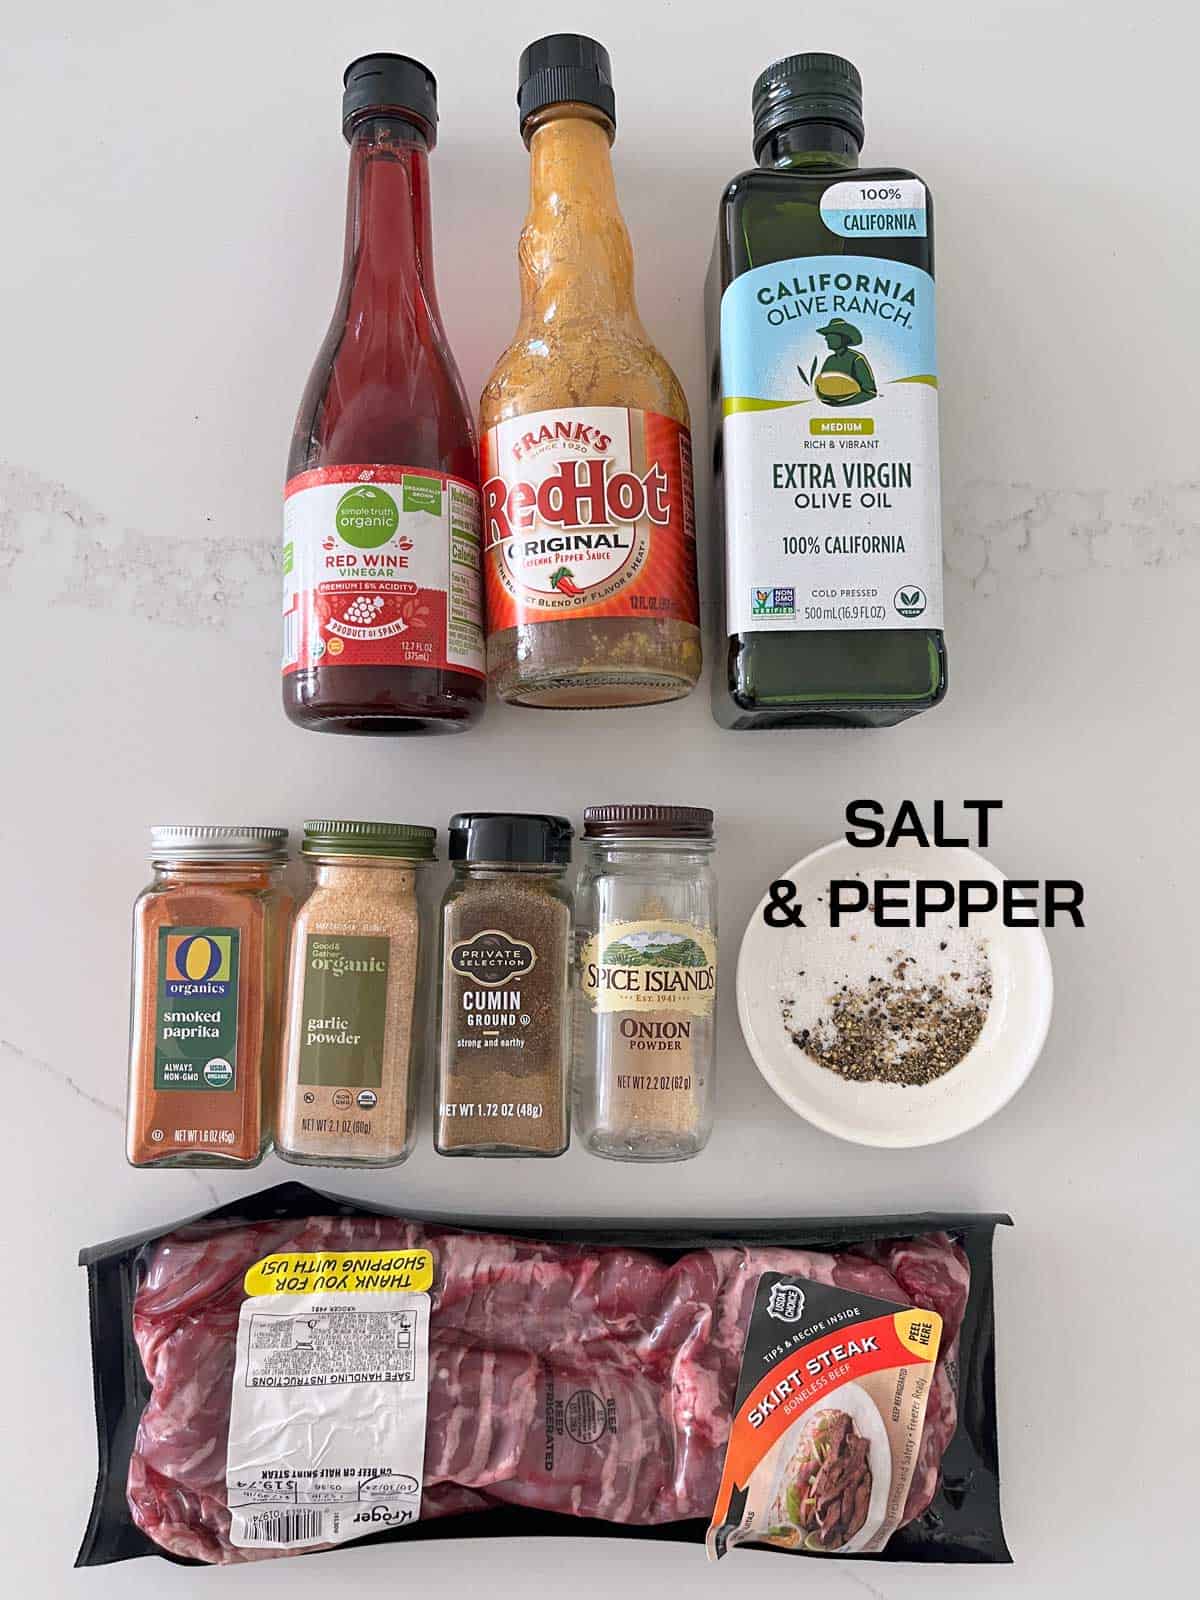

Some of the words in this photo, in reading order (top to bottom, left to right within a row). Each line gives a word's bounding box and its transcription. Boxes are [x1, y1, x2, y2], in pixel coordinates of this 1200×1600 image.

[860, 188, 901, 201] 100%
[843, 214, 917, 231] CALIFORNIA
[757, 273, 916, 306] CALIFORNIA
[766, 296, 828, 326] OLIVE
[833, 295, 911, 327] RANCH
[821, 423, 862, 431] MEDIUM
[512, 421, 611, 460] FRANK'S
[804, 440, 826, 449] RICH
[829, 440, 835, 449] &
[839, 440, 879, 449] VIBRANT
[562, 443, 588, 454] 1920
[773, 462, 837, 489] EXTRA
[843, 462, 912, 489] VIRGIN
[482, 459, 670, 552] RedHot
[795, 493, 852, 508] OLIVE
[860, 493, 892, 508] OIL
[341, 508, 368, 517] simple
[370, 507, 394, 516] truth
[341, 515, 394, 529] organic
[783, 536, 820, 554] 100%
[825, 536, 905, 554] CALIFORNIA
[326, 555, 357, 569] RED
[363, 555, 409, 569] WINE
[555, 552, 583, 565] PEPPER
[586, 551, 611, 561] SAUCE
[339, 568, 394, 577] VINEGAR
[380, 583, 415, 591] ACIDITY
[538, 598, 571, 608] BLEND
[573, 596, 587, 605] OF
[590, 577, 628, 602] FLAVOR
[811, 590, 837, 598] COLD
[840, 589, 879, 598] PRESSED
[331, 623, 365, 638] PRODUCT
[378, 622, 402, 637] SPAIN
[462, 950, 521, 958] PRIVATE
[311, 957, 386, 977] organic
[588, 963, 640, 991] SPICE
[645, 966, 714, 991] ISLANDS
[170, 981, 225, 996] organics
[463, 992, 521, 1010] CUMIN
[163, 1011, 221, 1023] smoked
[308, 1017, 349, 1031] garlic
[467, 1015, 516, 1026] GROUND
[163, 1026, 220, 1040] paprika
[620, 1018, 691, 1039] ONION
[306, 1031, 361, 1046] powder
[457, 1039, 481, 1049] strong
[484, 1038, 498, 1047] and
[501, 1038, 525, 1049] earthy
[630, 1041, 682, 1050] POWDER
[164, 1063, 193, 1071] ALWAYS
[164, 1073, 199, 1081] NON-GMO
[617, 1075, 630, 1089] NET
[632, 1075, 644, 1089] WT
[646, 1076, 658, 1090] 2.2
[660, 1076, 670, 1090] OZ
[440, 1104, 457, 1117] NET
[460, 1104, 474, 1117] WT
[477, 1104, 498, 1117] 1.72
[501, 1104, 514, 1117] OZ
[516, 1103, 543, 1118] (48g)
[302, 1118, 314, 1132] NET
[316, 1119, 327, 1132] WT
[342, 1120, 351, 1133] OZ
[174, 1129, 186, 1142] NET
[188, 1130, 198, 1142] WT
[261, 1261, 288, 1276] US!
[294, 1258, 337, 1274] WITH
[343, 1256, 427, 1273] SHOPPING
[275, 1277, 308, 1291] FOR
[313, 1275, 349, 1290] YOU
[355, 1275, 412, 1288] THANK
[774, 1287, 785, 1313] USDA
[784, 1290, 798, 1318] CHOICE
[763, 1346, 784, 1363] TIPS
[784, 1340, 792, 1349] &
[793, 1322, 826, 1343] RECIPE
[826, 1307, 861, 1324] INSIDE
[908, 1321, 921, 1344] PEEL
[920, 1321, 933, 1346] HERE
[252, 1375, 328, 1386] INSTRUCTIONS
[330, 1373, 382, 1383] HANDLING
[385, 1371, 411, 1381] SAFE
[747, 1369, 804, 1429] SKIRT
[805, 1336, 880, 1377] STEAK
[783, 1376, 829, 1416] BONELESS
[828, 1363, 851, 1382] BEEF
[911, 1377, 928, 1401] Ready
[545, 1361, 554, 1471] REFRIGERATED
[555, 1400, 564, 1435] KEEP
[607, 1398, 617, 1434] BEEF
[907, 1400, 922, 1431] Freezer
[903, 1440, 916, 1464] Safety
[261, 1470, 290, 1480] STEAK
[293, 1470, 318, 1479] SKIRT
[320, 1468, 341, 1479] HALF
[359, 1468, 378, 1478] BEEF
[237, 1480, 295, 1490] $19.74
[252, 1509, 281, 1522] 01974
[353, 1505, 412, 1526] Kroger
